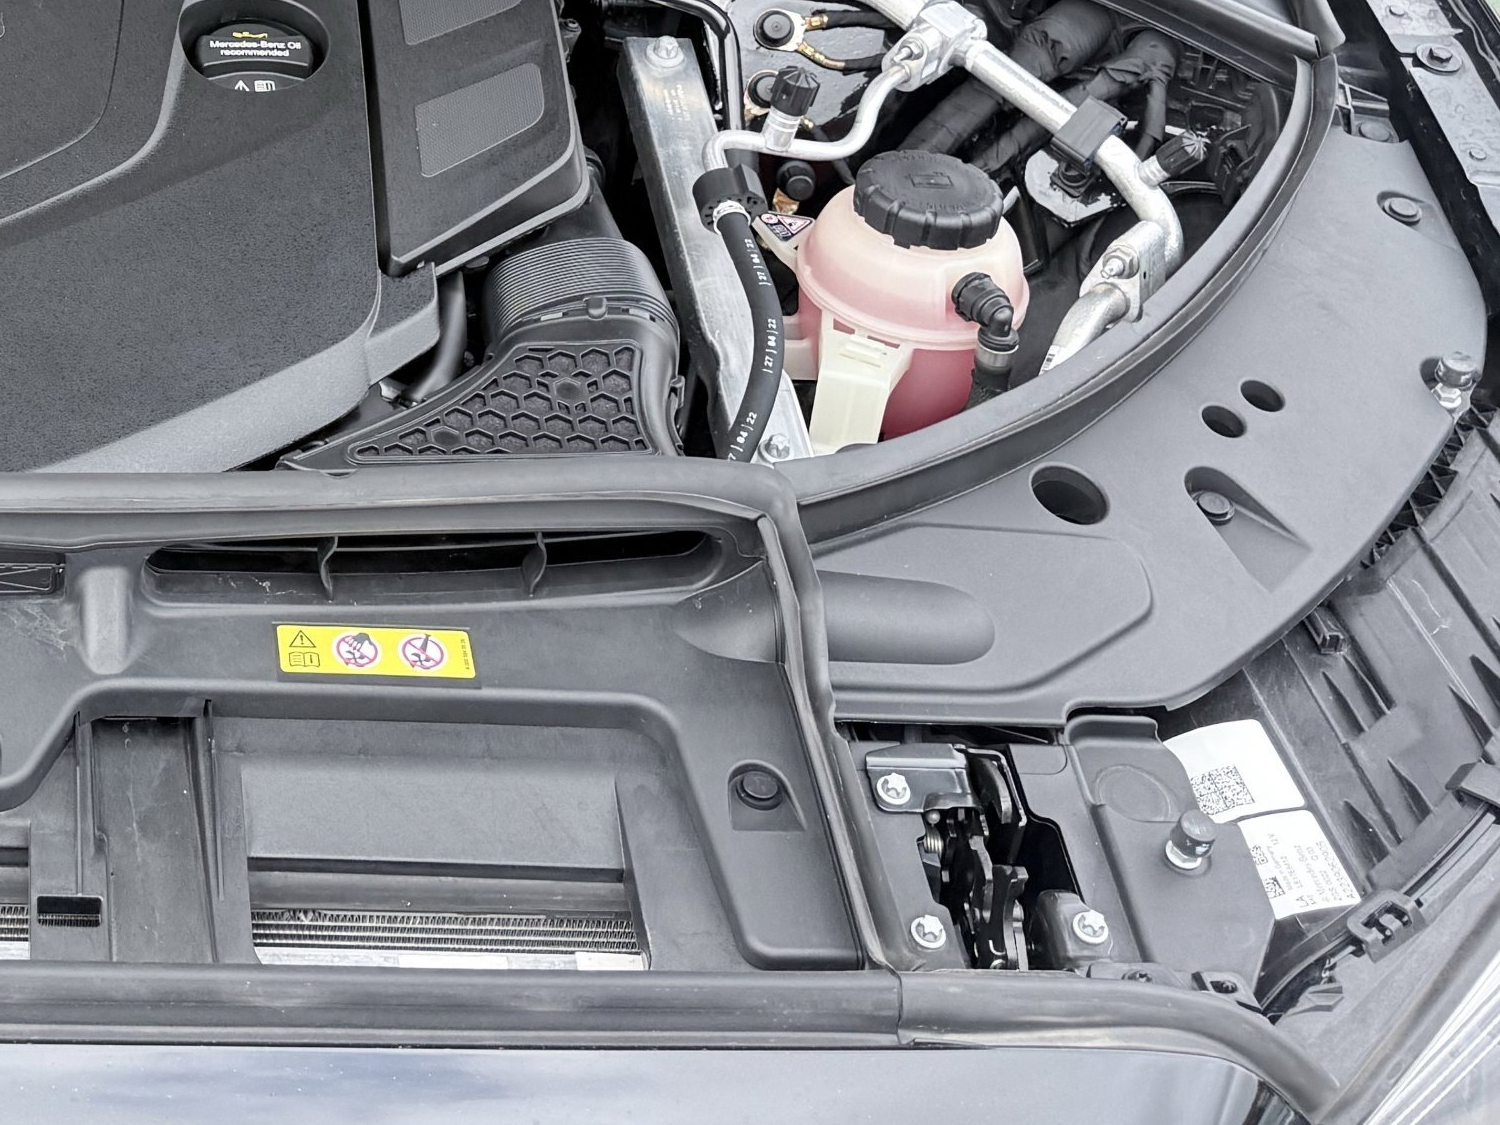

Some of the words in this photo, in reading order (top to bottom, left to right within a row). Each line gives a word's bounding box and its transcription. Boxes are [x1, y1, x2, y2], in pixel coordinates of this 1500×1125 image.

[209, 40, 286, 49] Mercedes-Benz
[287, 40, 302, 49] Oil
[220, 48, 290, 57] recommended
